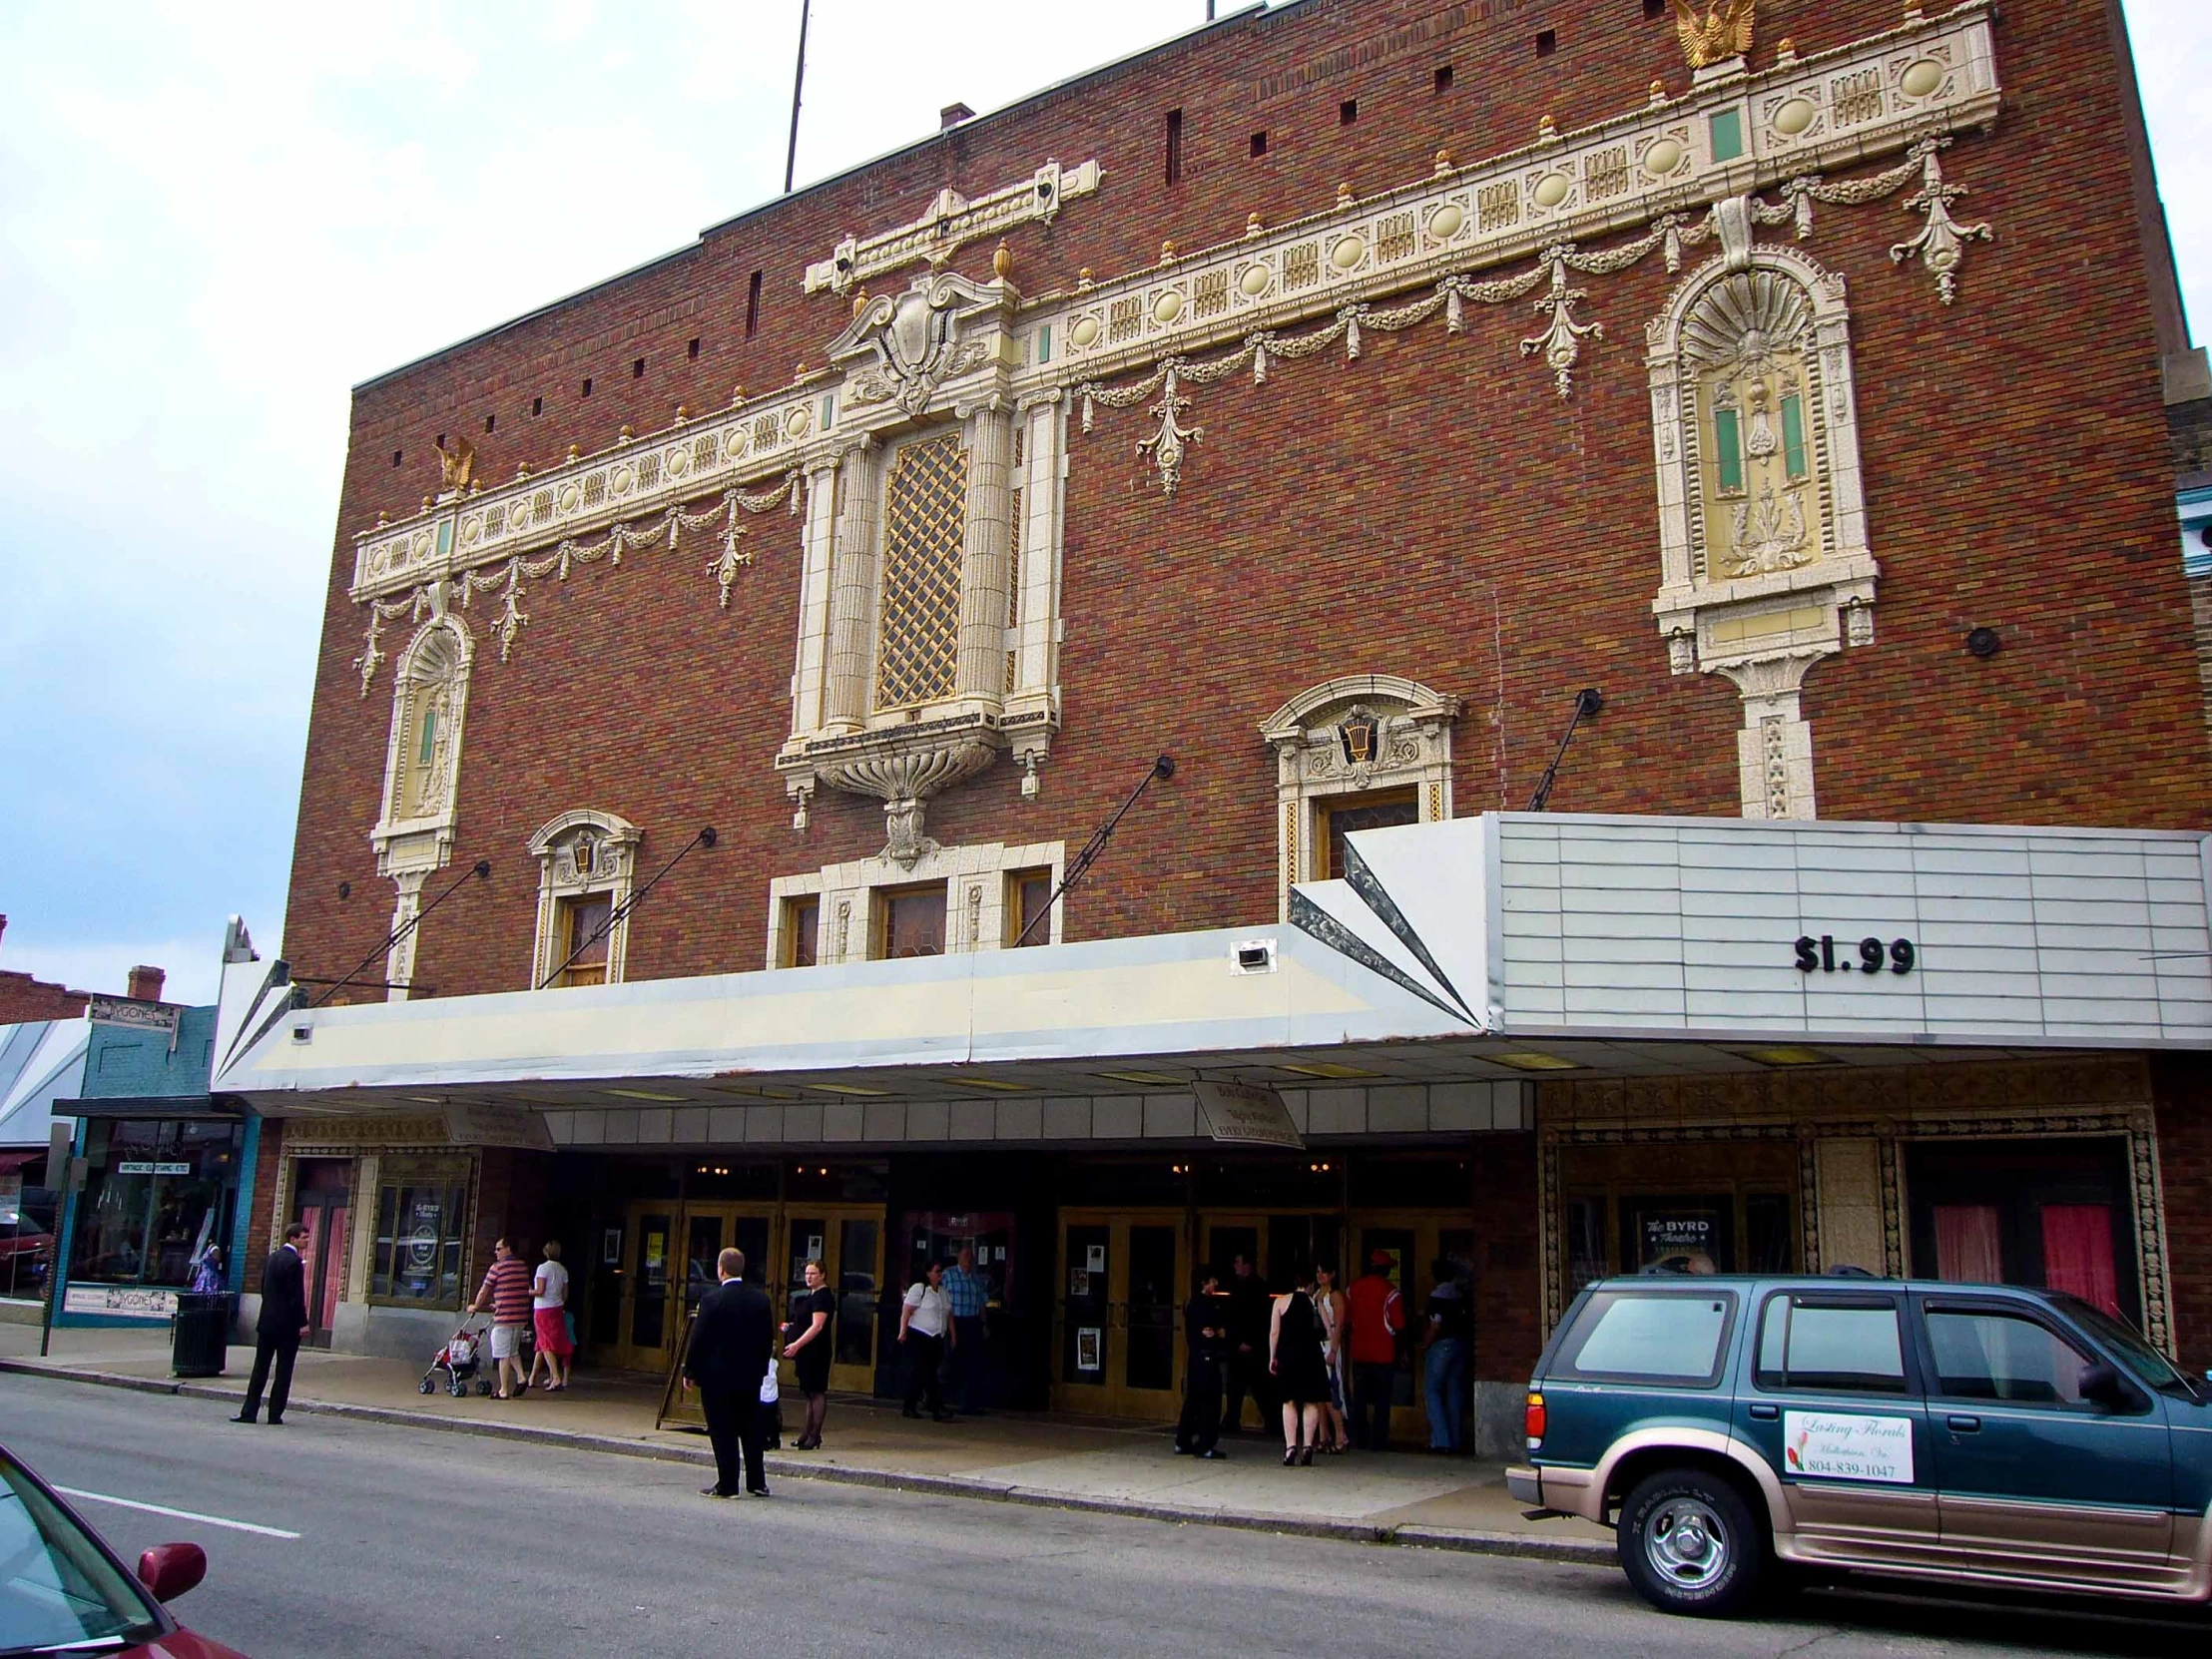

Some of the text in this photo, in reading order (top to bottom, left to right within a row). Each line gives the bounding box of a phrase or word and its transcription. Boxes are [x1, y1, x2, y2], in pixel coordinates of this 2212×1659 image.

[1647, 1220, 1710, 1233] The BYRD
[1803, 1415, 1906, 1439] Lasting Florals
[1809, 1459, 1896, 1477] 804-839-1047
